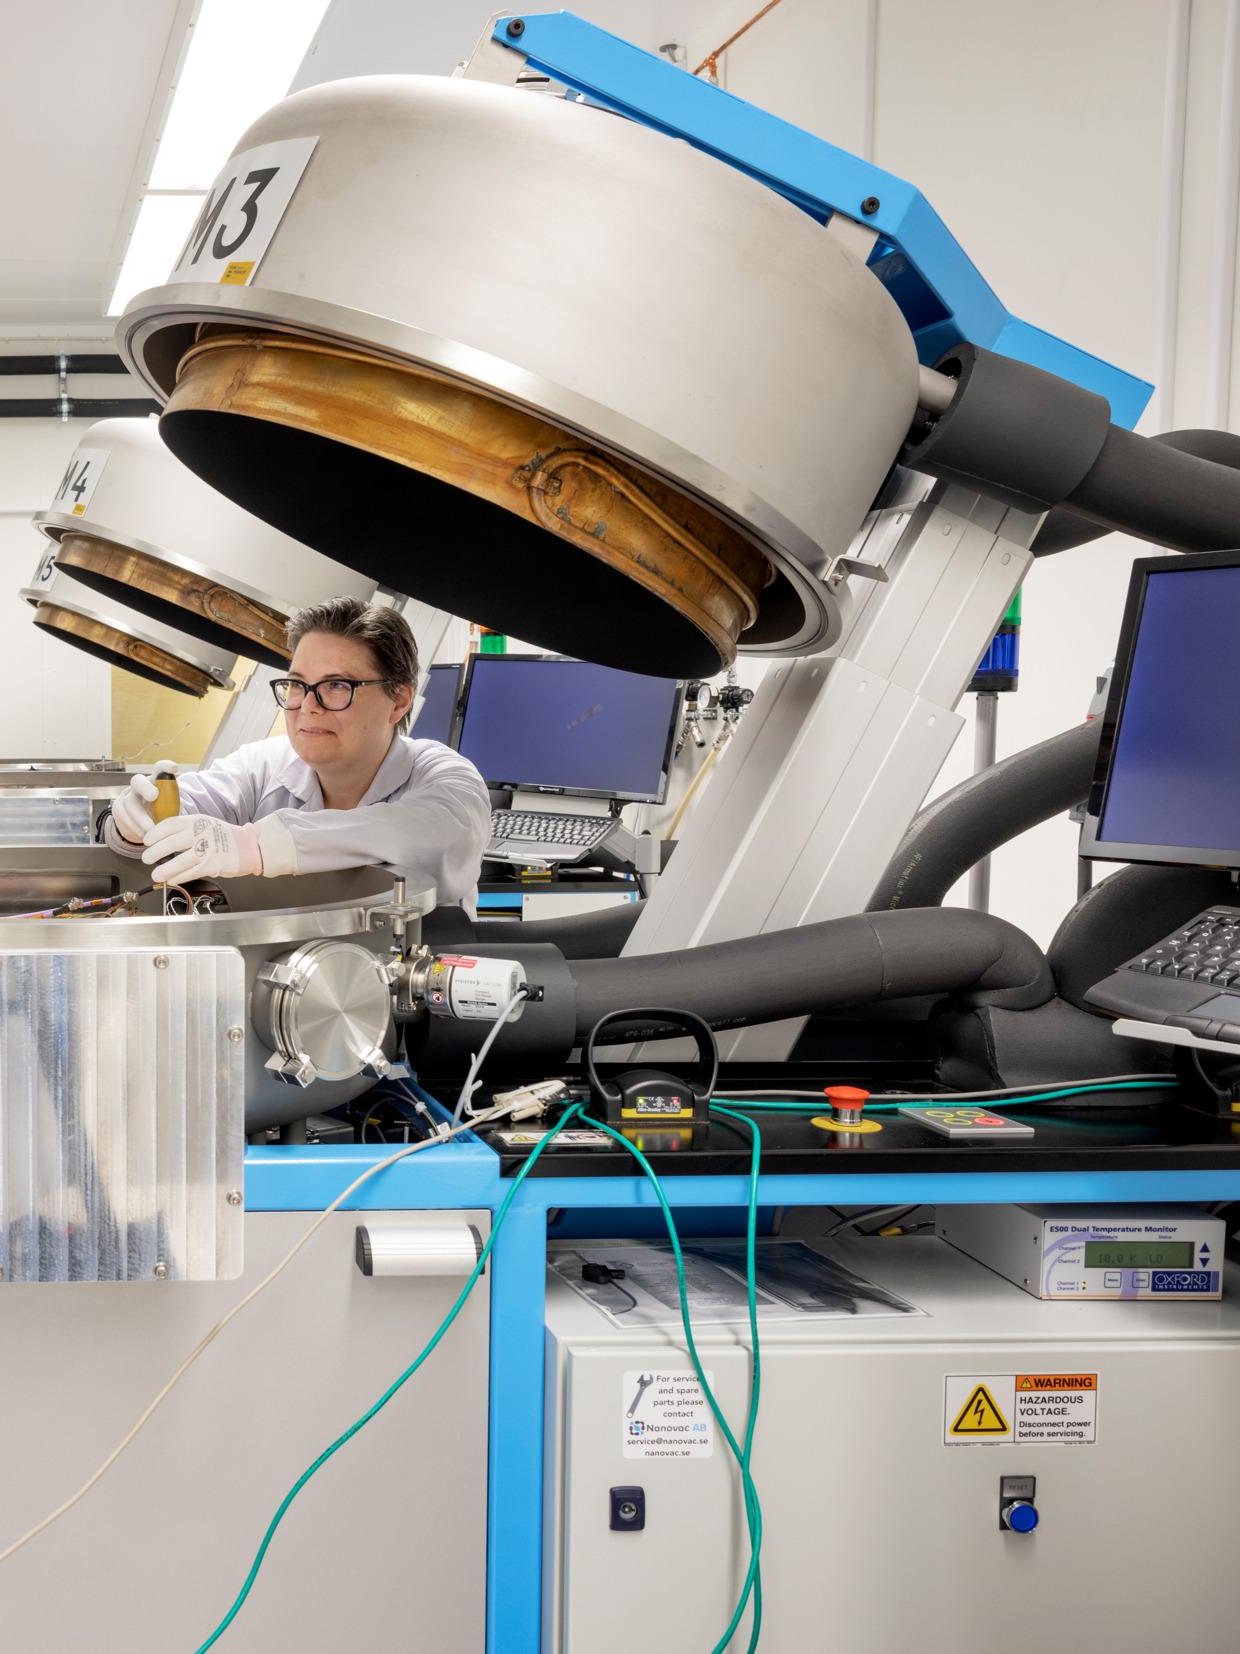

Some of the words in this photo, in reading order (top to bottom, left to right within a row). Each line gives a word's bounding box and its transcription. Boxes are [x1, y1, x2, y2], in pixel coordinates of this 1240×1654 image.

[175, 166, 280, 272] M3
[55, 461, 91, 502] M4
[1049, 1225, 1069, 1233] E500
[1071, 1225, 1089, 1233] Dual
[1092, 1225, 1142, 1234] Temperature
[1144, 1225, 1178, 1233] Monitor
[1154, 1273, 1208, 1285] OXFORD
[1033, 1377, 1093, 1388] WARNING
[676, 1387, 699, 1395] spare
[653, 1399, 675, 1407] parts
[676, 1398, 704, 1407] please
[1019, 1395, 1084, 1405] HAZARDOUS
[1019, 1407, 1071, 1416] VOLTAGE.
[646, 1424, 690, 1432] Nanovac
[692, 1423, 707, 1432] AB
[1066, 1421, 1092, 1429] power
[1018, 1430, 1045, 1438] before
[1046, 1430, 1086, 1439] servicing.
[627, 1437, 709, 1445] service@nanovac.se
